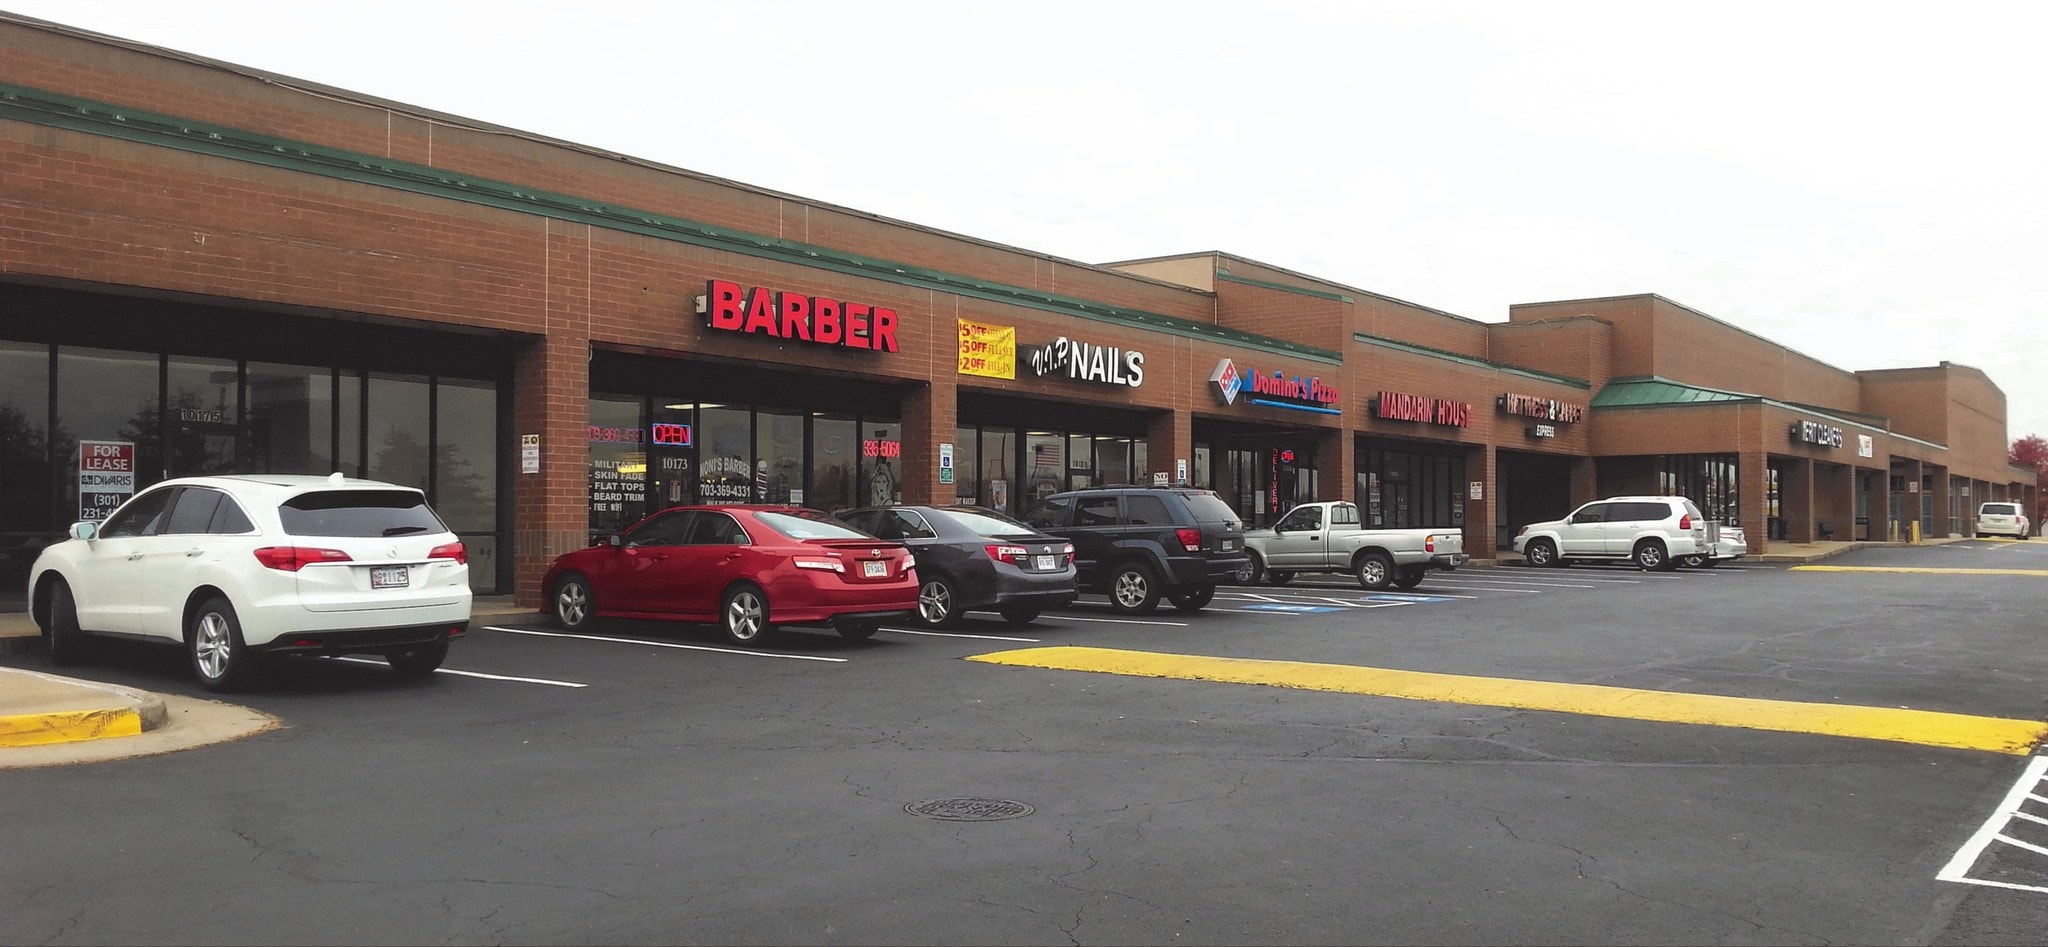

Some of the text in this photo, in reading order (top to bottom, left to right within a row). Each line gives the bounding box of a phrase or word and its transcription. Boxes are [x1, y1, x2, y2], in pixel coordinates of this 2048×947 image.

[711, 279, 899, 353] BARBER
[971, 324, 988, 336] OFF
[971, 341, 988, 353] OFF
[971, 357, 986, 369] OFF
[1070, 340, 1144, 387] NAILS
[1252, 368, 1308, 400] Domino's
[1380, 391, 1433, 424] MANDARIN
[1549, 399, 1556, 420] &
[181, 408, 221, 423] 10175
[654, 425, 689, 443] OPEN
[94, 445, 121, 457] FOR
[86, 458, 128, 470] LEASE
[663, 457, 688, 470] 10173
[94, 475, 132, 486] DIVARIS
[594, 470, 645, 480] SKIN FADE
[594, 482, 645, 491] FLAT TOPS
[700, 484, 750, 497] 703-369-4331
[94, 494, 120, 507] (301)
[593, 492, 645, 502] BEARD TRIM
